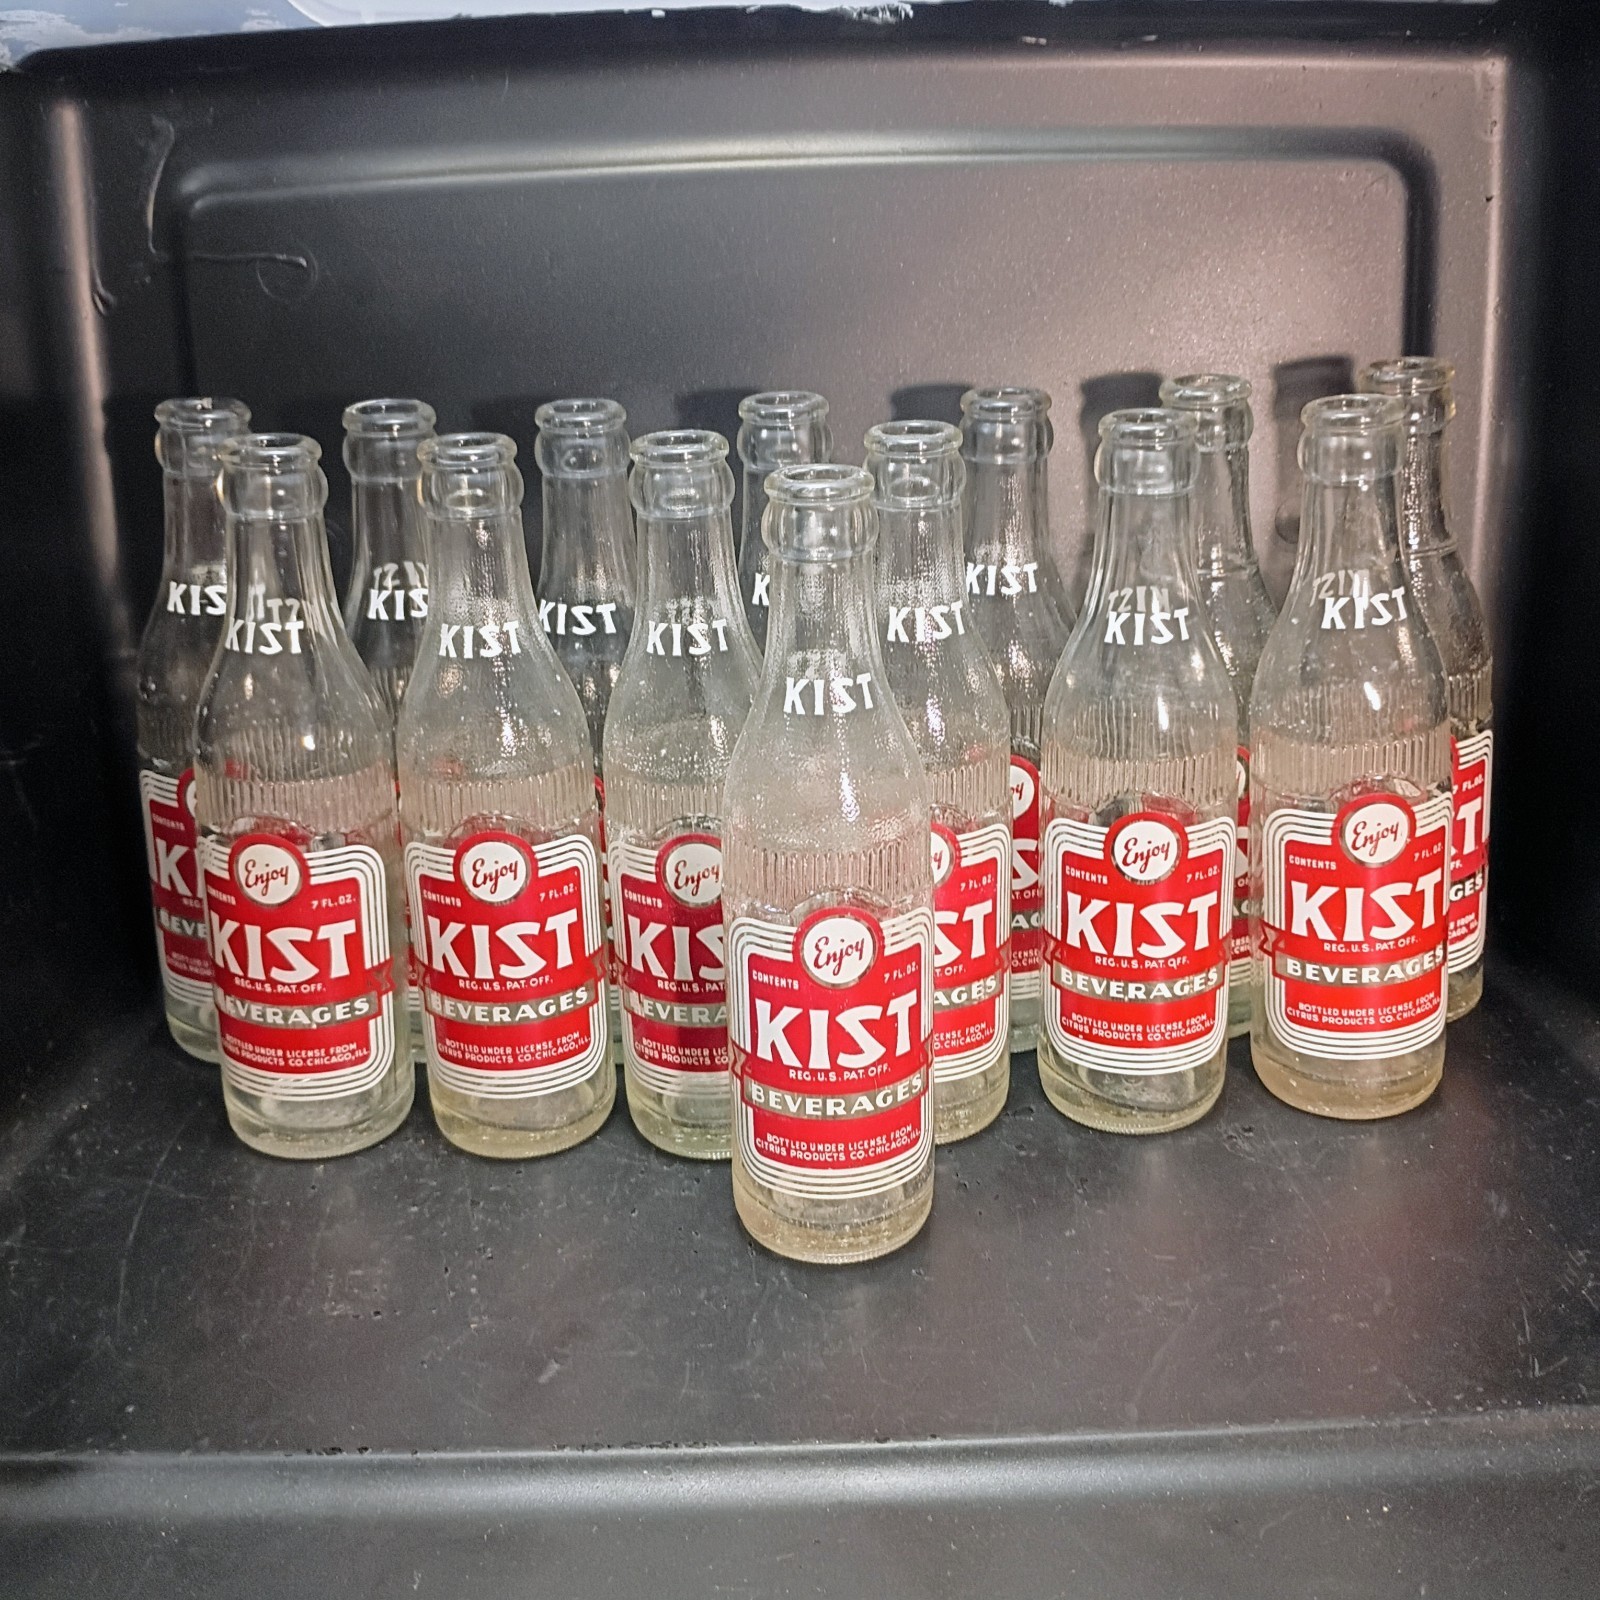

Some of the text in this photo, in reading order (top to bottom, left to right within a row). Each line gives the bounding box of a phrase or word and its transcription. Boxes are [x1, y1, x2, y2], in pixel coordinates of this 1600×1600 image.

[966, 561, 1038, 596] KIST
[167, 581, 227, 616] KIS
[367, 588, 429, 621] KIS
[1320, 585, 1407, 630] KIST
[539, 598, 617, 635] KIST
[887, 600, 965, 643] KIST
[1103, 607, 1190, 646] KIST
[224, 616, 304, 655] KIST
[438, 620, 522, 659] KIST
[646, 618, 728, 656] KIST
[783, 672, 874, 715] KIST
[1122, 837, 1170, 874] Enjoy
[1351, 820, 1399, 857] Enjoy
[244, 859, 289, 896] Enjoy
[472, 857, 518, 895] Enjoy
[674, 859, 720, 897] Enjoy
[1065, 865, 1108, 885] CONTENTS
[1186, 873, 1192, 884] 7
[1288, 854, 1337, 870] CONTENTS
[1414, 852, 1420, 862] 7
[311, 900, 318, 910] 7
[423, 889, 462, 908] CONTENTS
[539, 892, 546, 902] 7
[624, 889, 663, 908] CONTENTS
[1290, 867, 1442, 942] KIST
[1066, 890, 1218, 959] KIST
[210, 909, 356, 984] KIST
[427, 907, 578, 979] KIST
[627, 914, 725, 981] KIS
[813, 936, 865, 976] Enjoy
[1012, 948, 1040, 960] CENSE
[752, 969, 799, 990] CONTENTS
[884, 973, 890, 983] 7
[1286, 943, 1444, 984] BEVERAGES
[1060, 967, 1218, 999] BEVERAGES
[430, 986, 588, 1022] BEVERAGES
[1287, 1007, 1319, 1022] CITRUS
[1321, 1016, 1375, 1025] PRODUCTS
[1298, 1002, 1338, 1017] BOTTLED
[1378, 1001, 1413, 1015] LICENSE
[1416, 991, 1435, 1005] FROM
[755, 989, 917, 1069] KIST
[934, 1021, 986, 1040] CENSE FROM
[1061, 1017, 1089, 1033] CITRUS
[1092, 1027, 1143, 1041] PRODUCTS
[1071, 1012, 1207, 1033] BOTTLED UNDER LICENSE FROM
[241, 1051, 285, 1066] PRODUCTS
[255, 1045, 283, 1057] UNDER
[287, 1046, 326, 1058] LICENSE
[330, 1042, 357, 1055] FROM
[438, 1043, 463, 1059] CITRUS
[465, 1053, 513, 1064] PRODUCTS
[445, 1031, 580, 1055] BOTTLED UNDER LICENSE FROM
[635, 1041, 729, 1065] CITRUS PRODUCTS CO
[642, 1037, 676, 1053] BOTTLED
[678, 1047, 709, 1057] UNDER
[751, 1073, 922, 1116] BEVERAGES
[755, 1138, 787, 1156] CITRUS
[790, 1150, 846, 1162] PRODUCTS
[766, 1123, 912, 1152] BOTTLED UNDER LICENSE FROM
